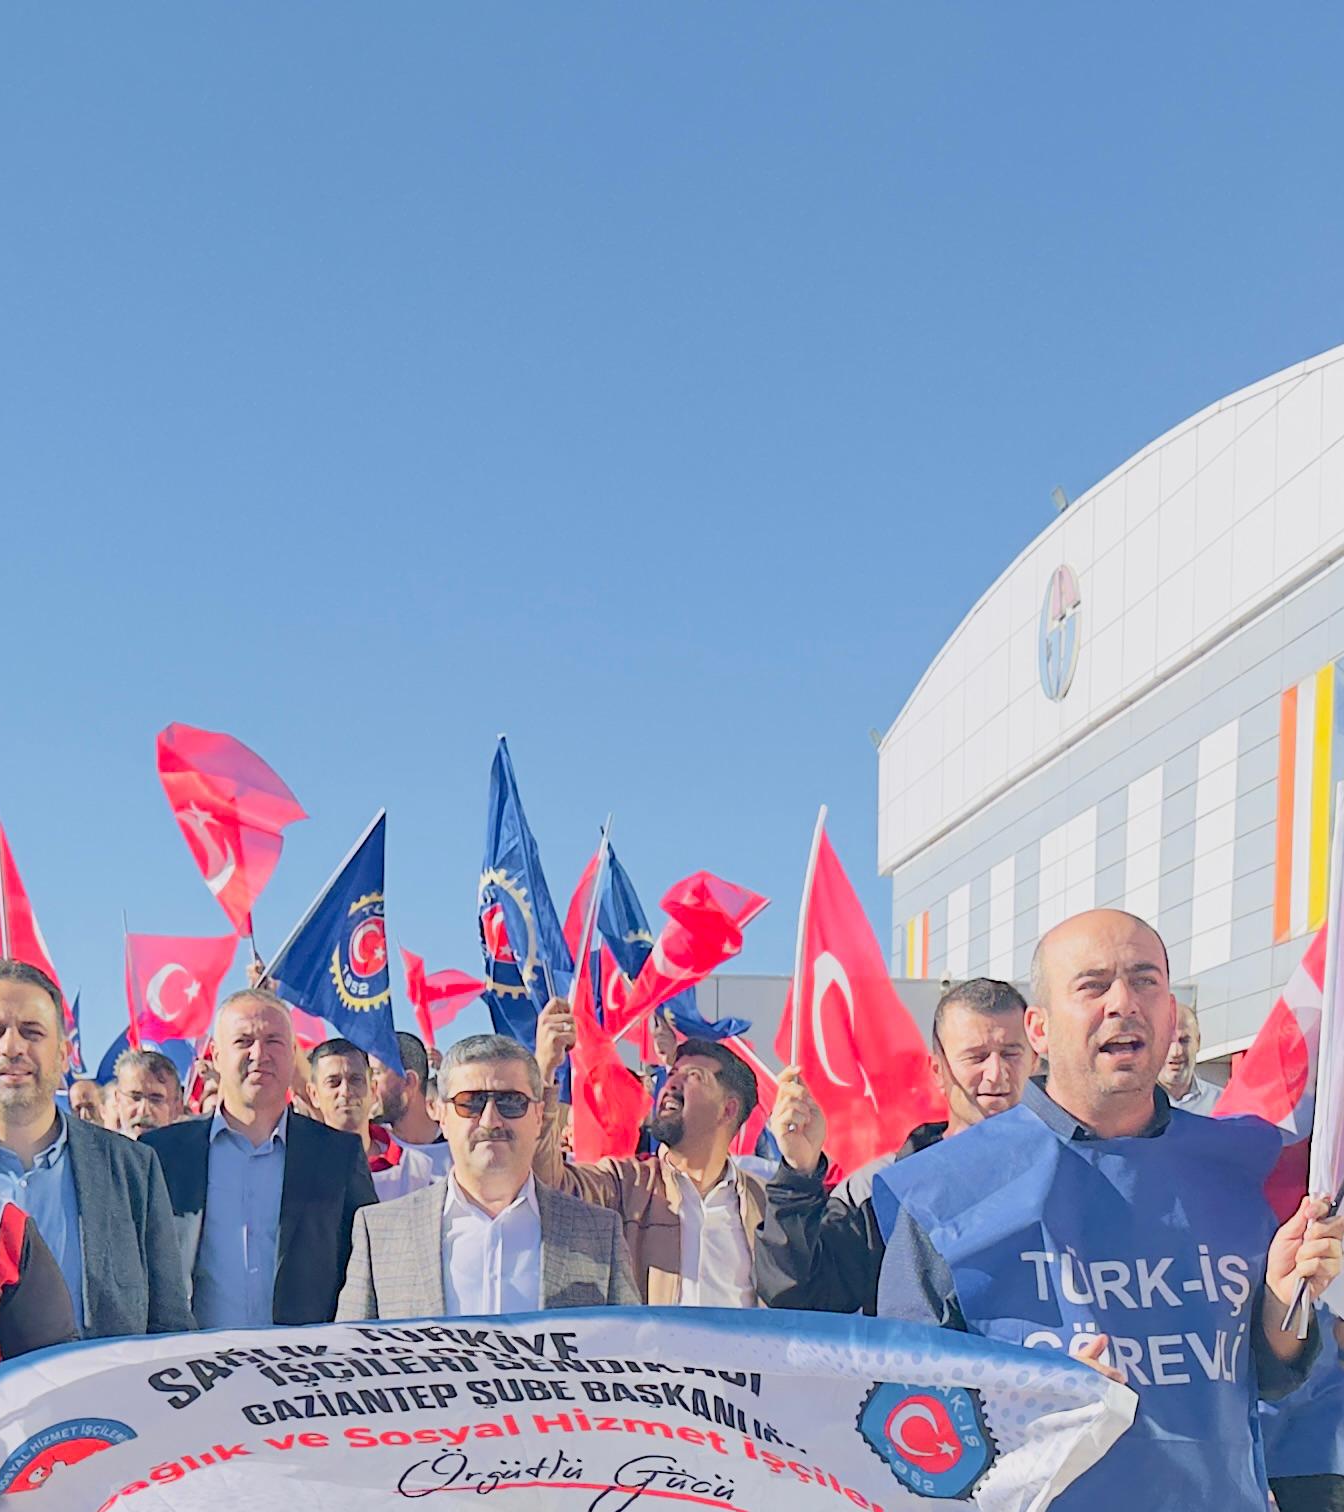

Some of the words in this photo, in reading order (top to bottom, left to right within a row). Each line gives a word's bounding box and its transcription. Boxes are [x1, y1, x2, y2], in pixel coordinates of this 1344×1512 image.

[1020, 1244, 1251, 1317] TÜRK-İŞ
[242, 1383, 459, 1426] GAZİANTEP
[466, 1378, 576, 1409] ŞUBE
[30, 1426, 78, 1452] HİZMET
[263, 1432, 329, 1451] ve
[343, 1415, 520, 1448] Sosyal
[532, 1407, 729, 1455] Hizmet
